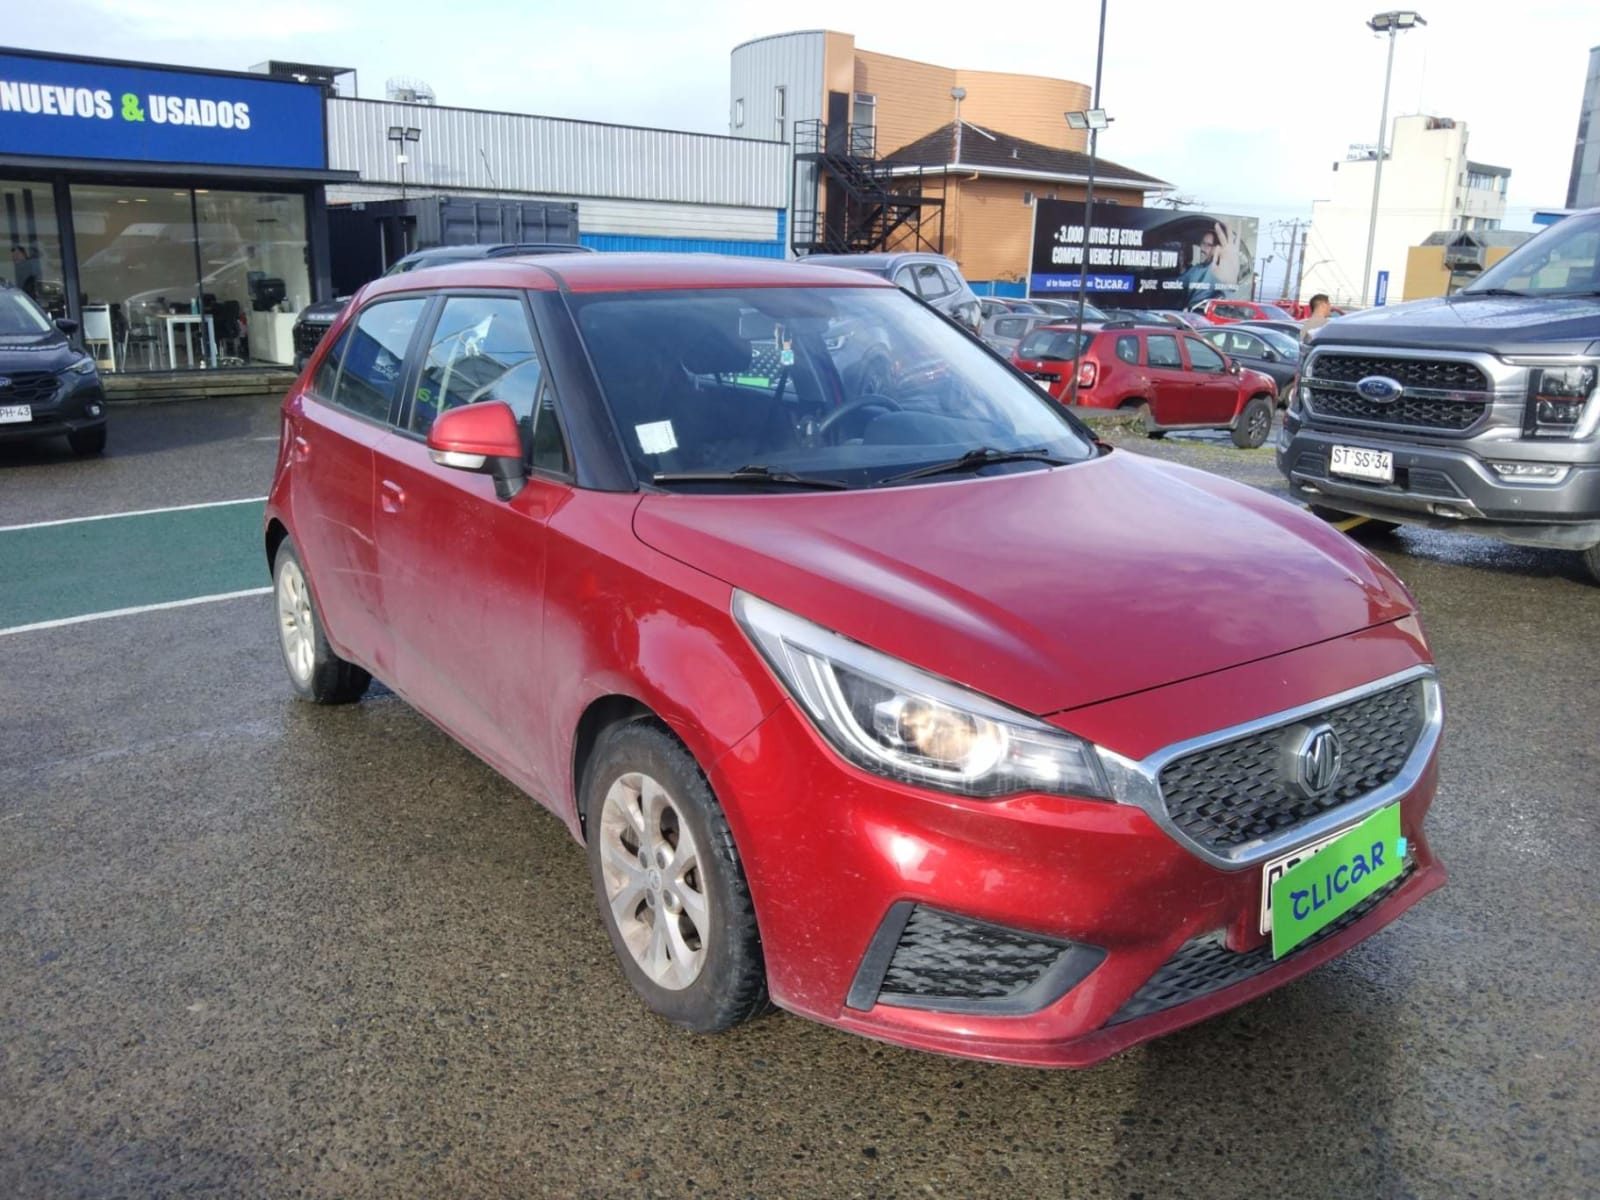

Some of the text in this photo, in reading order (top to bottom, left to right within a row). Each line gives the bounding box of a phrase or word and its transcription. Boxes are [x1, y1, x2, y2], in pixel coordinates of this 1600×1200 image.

[0, 81, 251, 130] NUEVOS & USADOS
[1120, 229, 1144, 247] STOCK
